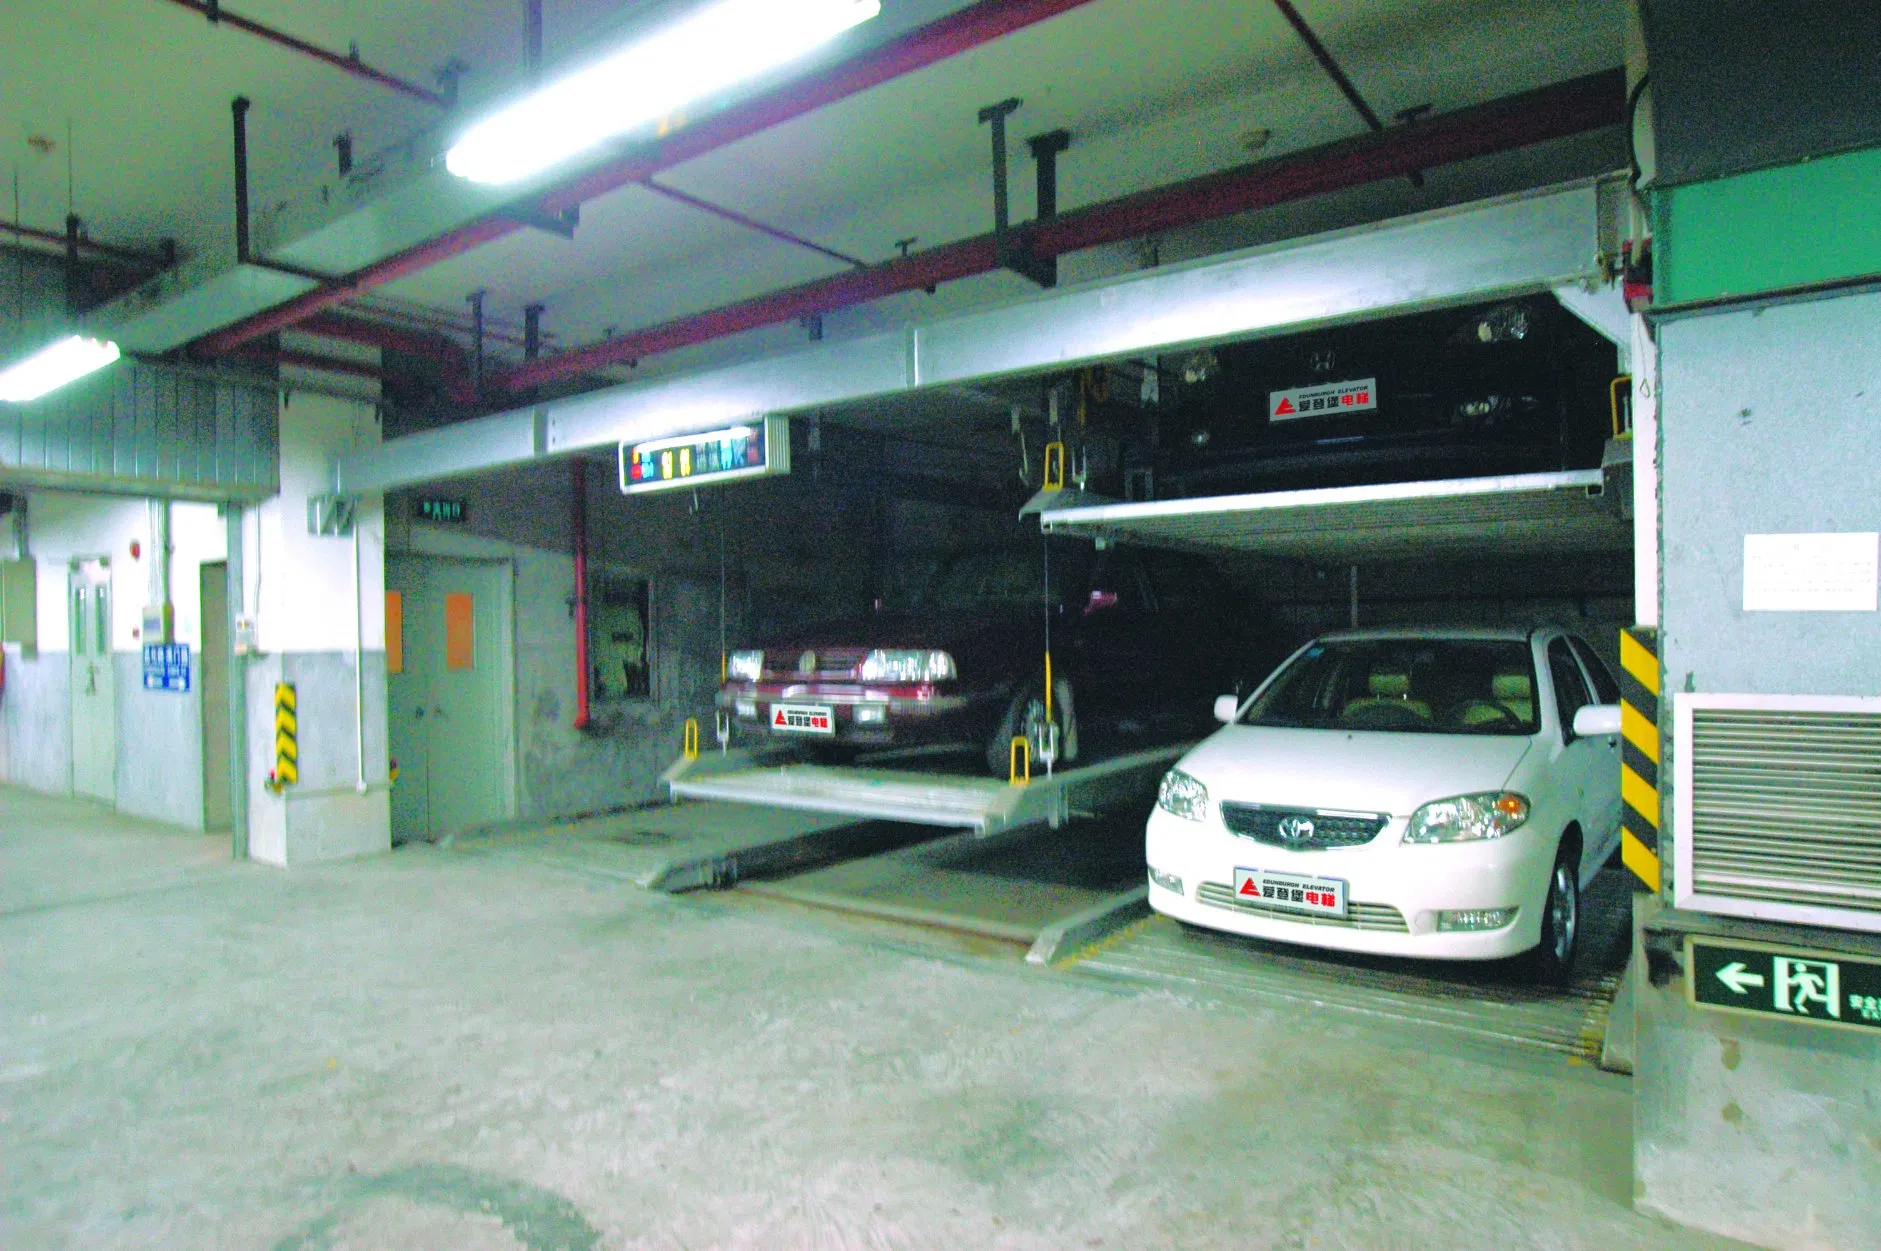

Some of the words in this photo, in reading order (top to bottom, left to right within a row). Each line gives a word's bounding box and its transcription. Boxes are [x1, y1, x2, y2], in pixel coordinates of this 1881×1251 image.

[1338, 386, 1368, 394] ELEVATOR
[1299, 392, 1369, 411] 爱登堡电梯
[1302, 884, 1335, 892] ELEVATOR
[1262, 885, 1336, 907] 爱登堡电梯
